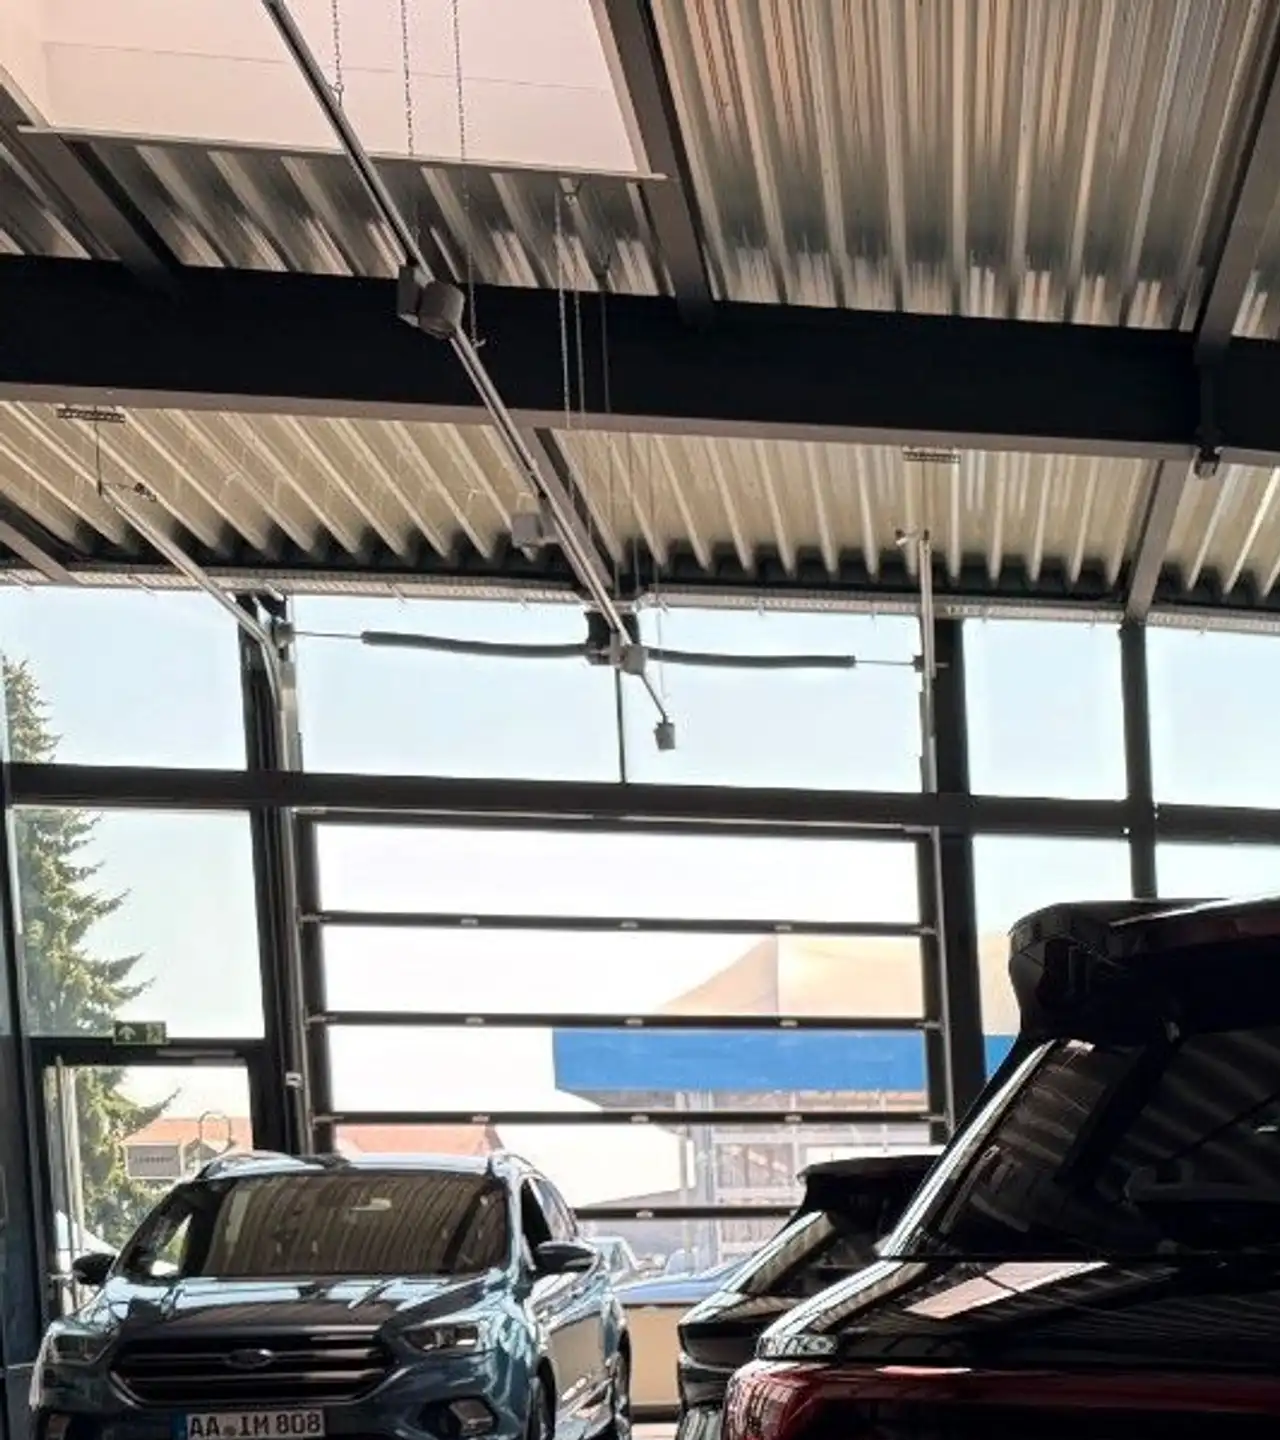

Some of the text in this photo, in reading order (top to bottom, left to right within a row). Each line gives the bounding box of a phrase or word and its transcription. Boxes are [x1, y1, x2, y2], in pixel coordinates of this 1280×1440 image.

[189, 1413, 321, 1437] AA IM 808
